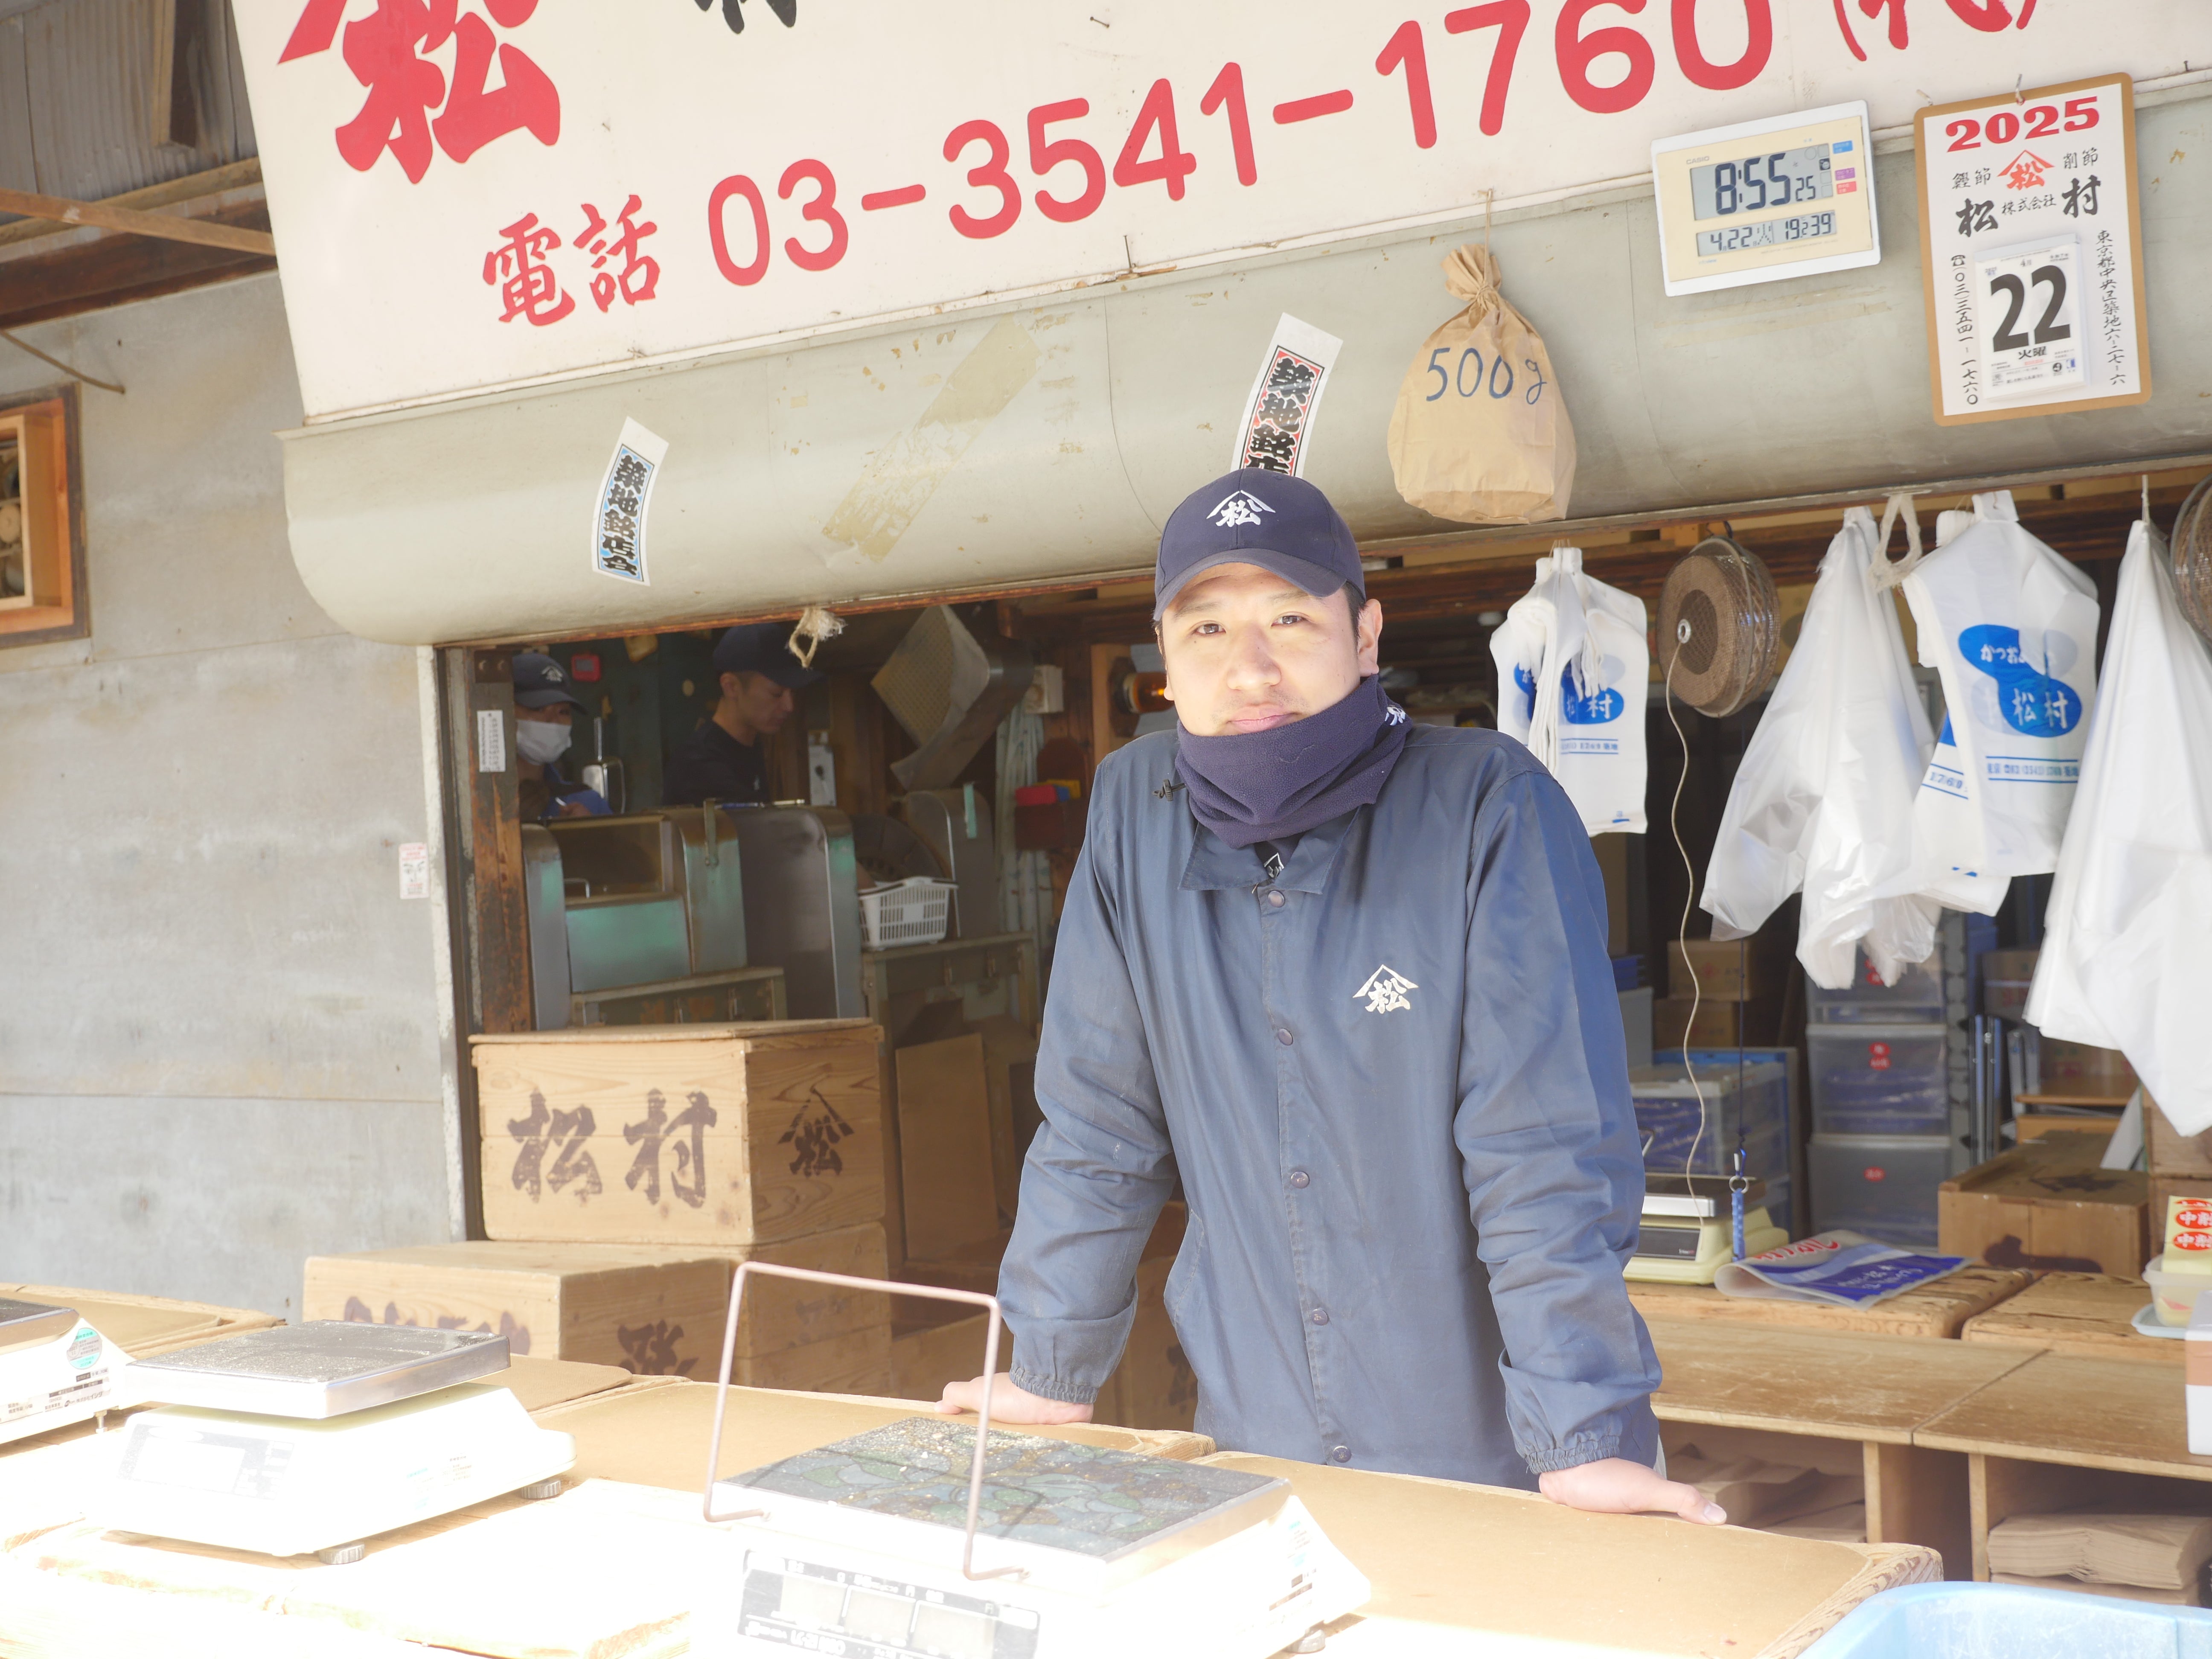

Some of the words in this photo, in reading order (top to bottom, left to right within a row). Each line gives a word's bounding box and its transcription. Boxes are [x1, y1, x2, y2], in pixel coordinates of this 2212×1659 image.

[1946, 96, 2099, 152] 2025
[483, 195, 660, 326] 電話
[709, 0, 1773, 286] 03-3541-1760
[1686, 156, 1709, 164] CASIO
[1715, 153, 1790, 215] 8:55
[1795, 175, 1815, 201] 25
[1952, 167, 1991, 189] 鰹節
[2063, 147, 2098, 169] 削節
[2002, 194, 2056, 215] 株式会社
[1990, 265, 2071, 352] 22
[1426, 347, 1547, 405] 500g
[2018, 346, 2047, 359] 火曜
[2011, 688, 2068, 729] 松村
[506, 1087, 717, 1208] 松村
